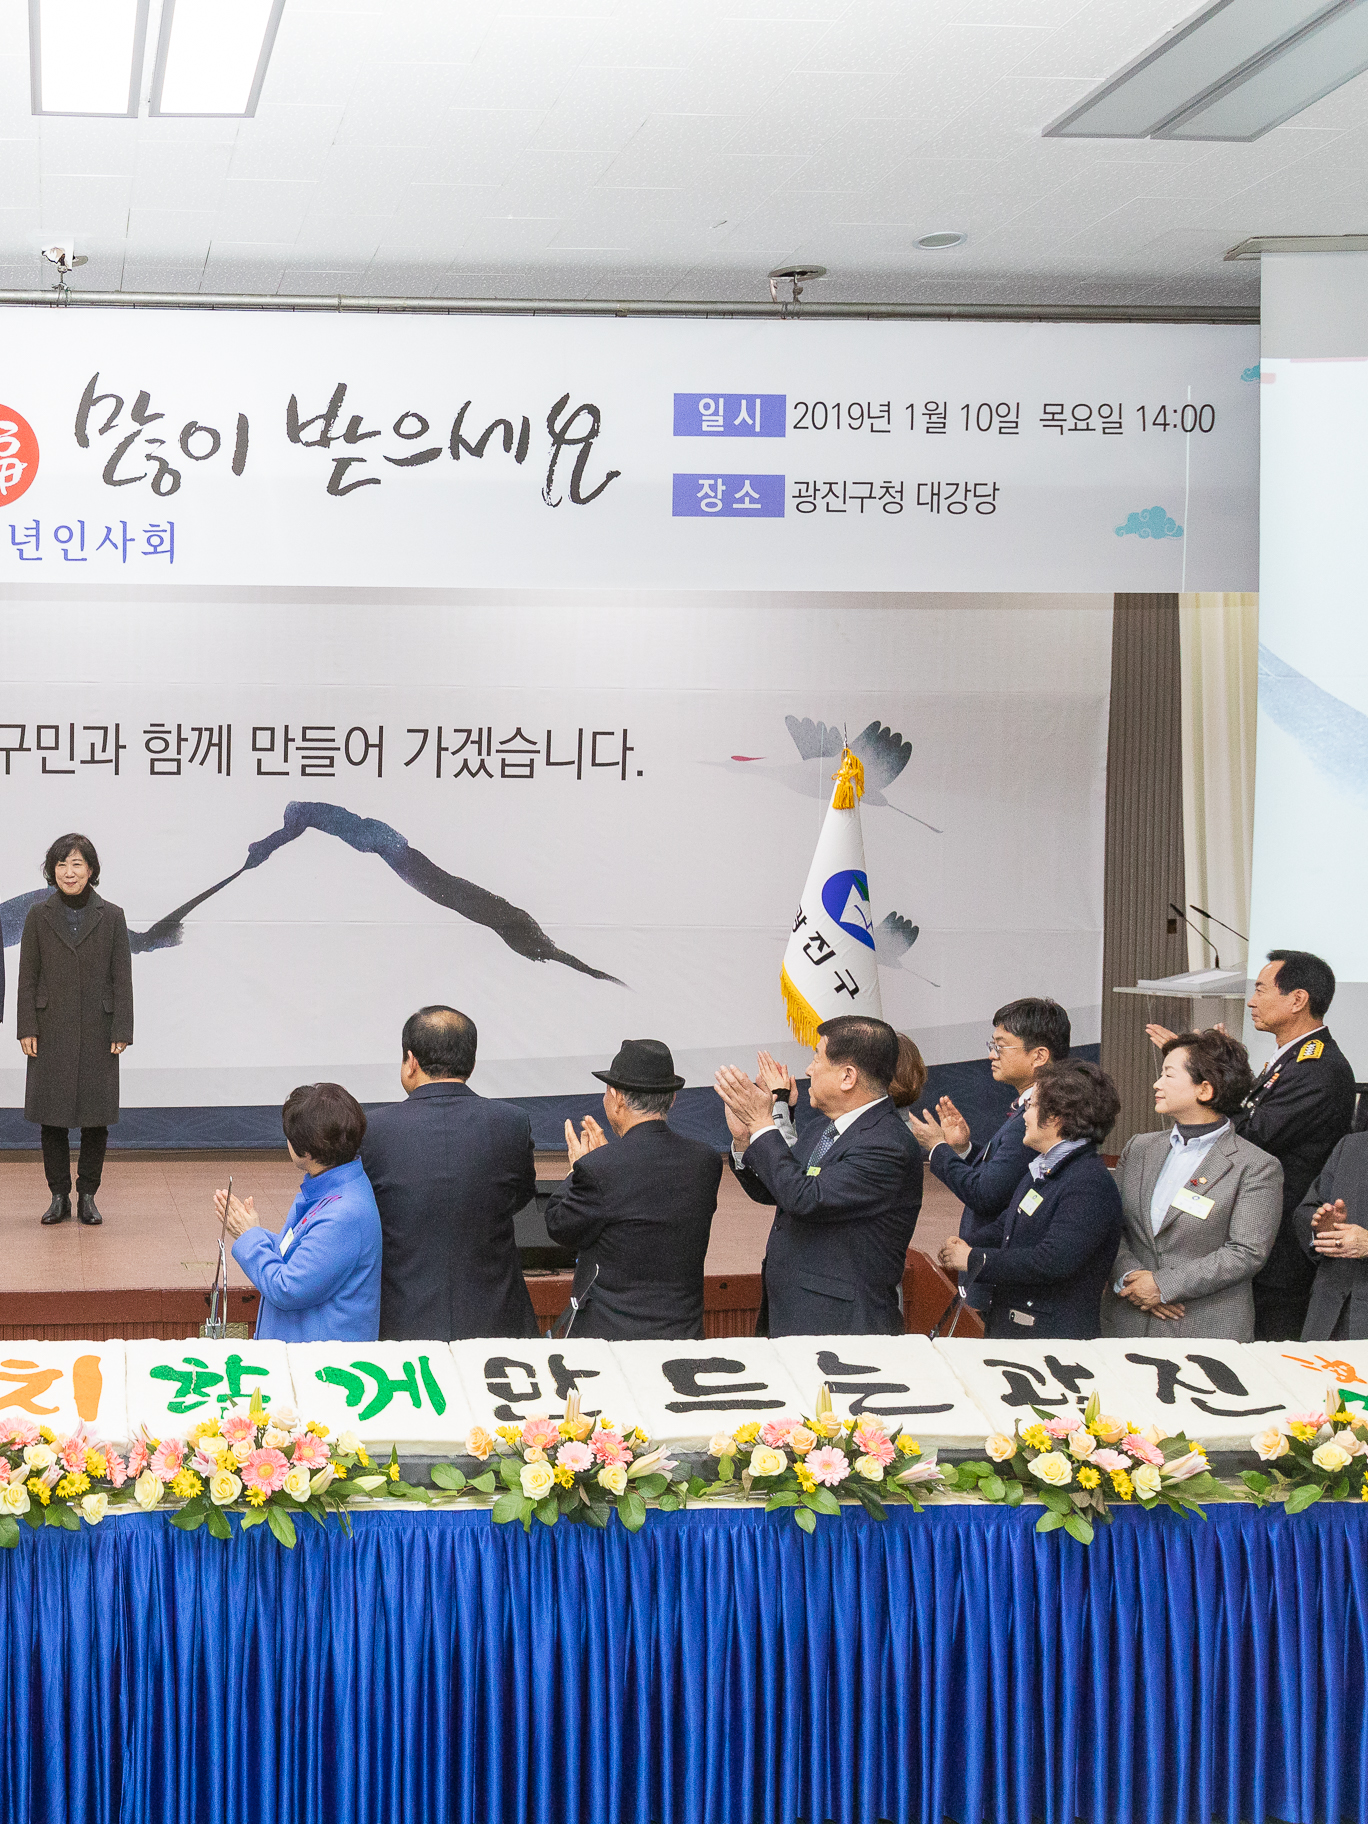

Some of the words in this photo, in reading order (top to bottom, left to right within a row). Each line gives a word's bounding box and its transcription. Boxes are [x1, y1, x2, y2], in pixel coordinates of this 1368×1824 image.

[75, 372, 249, 496] 많이
[286, 383, 621, 507] 받으세요
[793, 401, 890, 433] 2019년
[906, 401, 946, 434] 1월
[961, 403, 1019, 434] 10일
[1040, 403, 1123, 435] 목요일
[1137, 404, 1215, 433] 14:00
[792, 481, 903, 514] 광진구청
[917, 482, 999, 514] 대강당
[143, 724, 231, 776] 함께
[252, 725, 383, 777] 만들어
[404, 726, 643, 780] 가겠습니다.
